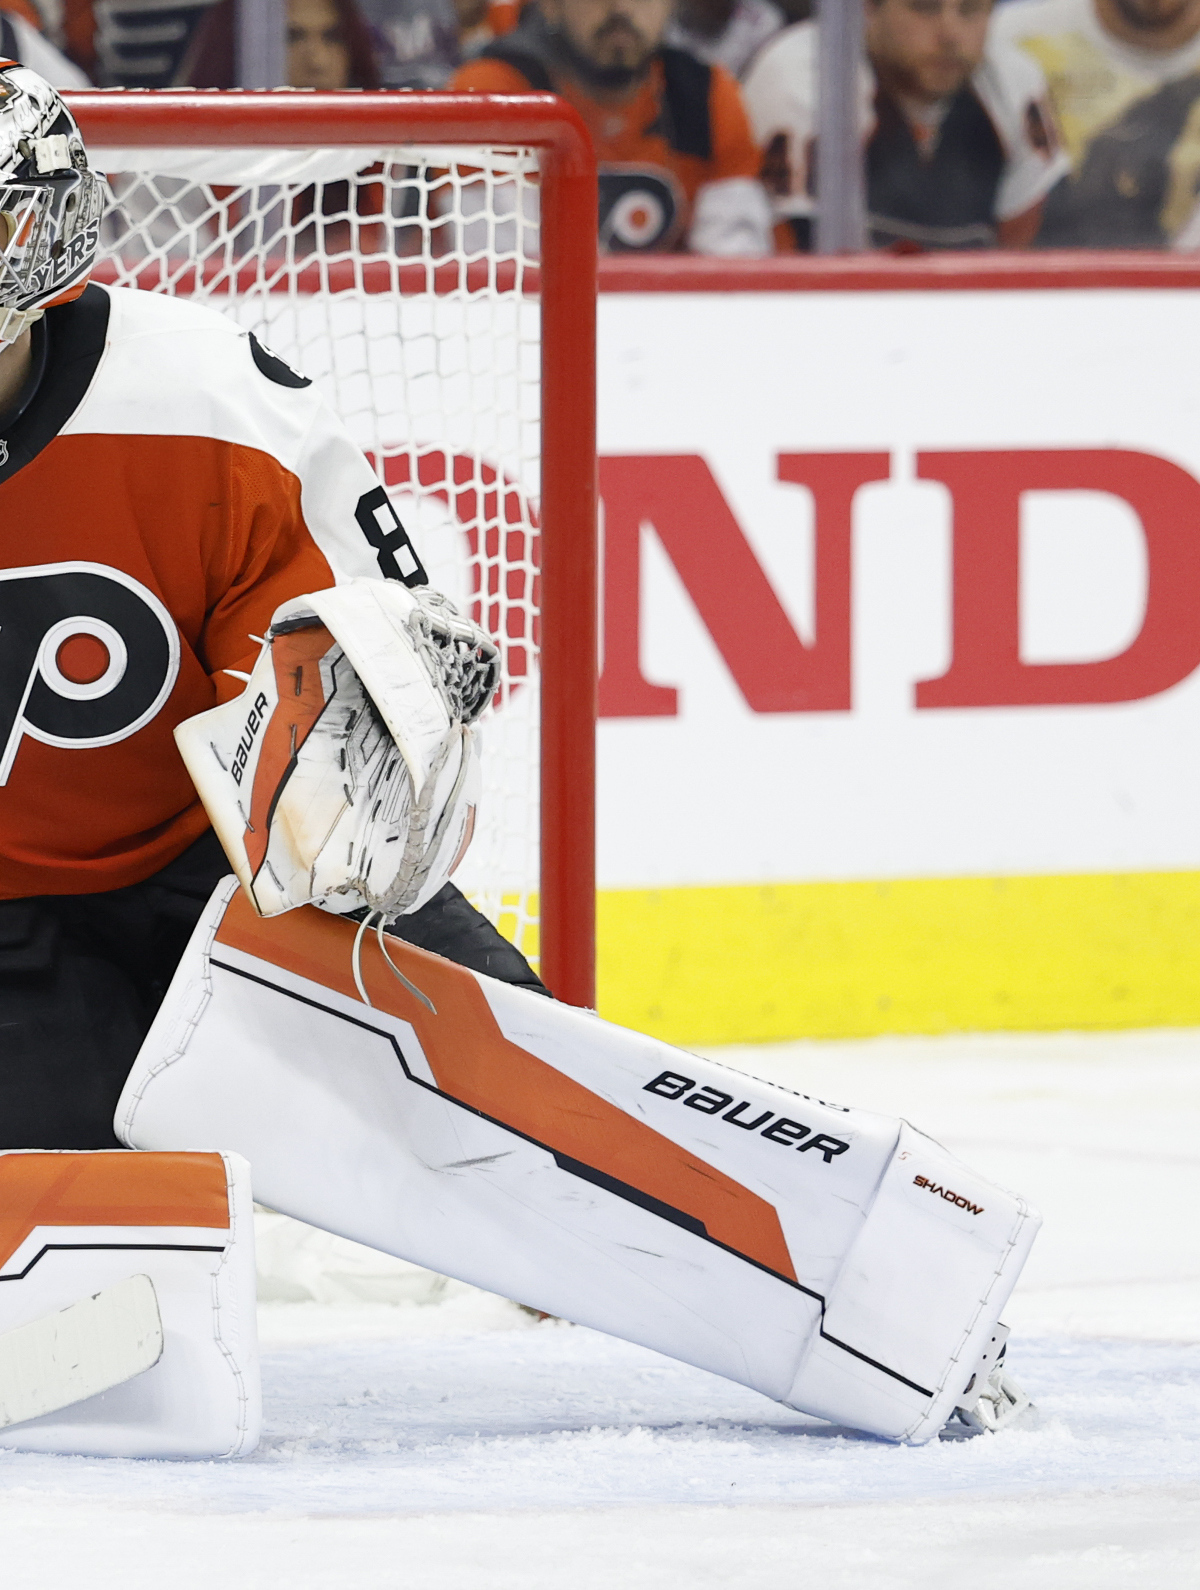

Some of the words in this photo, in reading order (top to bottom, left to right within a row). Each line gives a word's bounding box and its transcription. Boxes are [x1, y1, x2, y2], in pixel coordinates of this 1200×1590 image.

[31, 217, 99, 291] YERS
[230, 691, 269, 786] BAUER
[642, 1070, 850, 1164] BAUER
[912, 1174, 985, 1216] SHADOW
